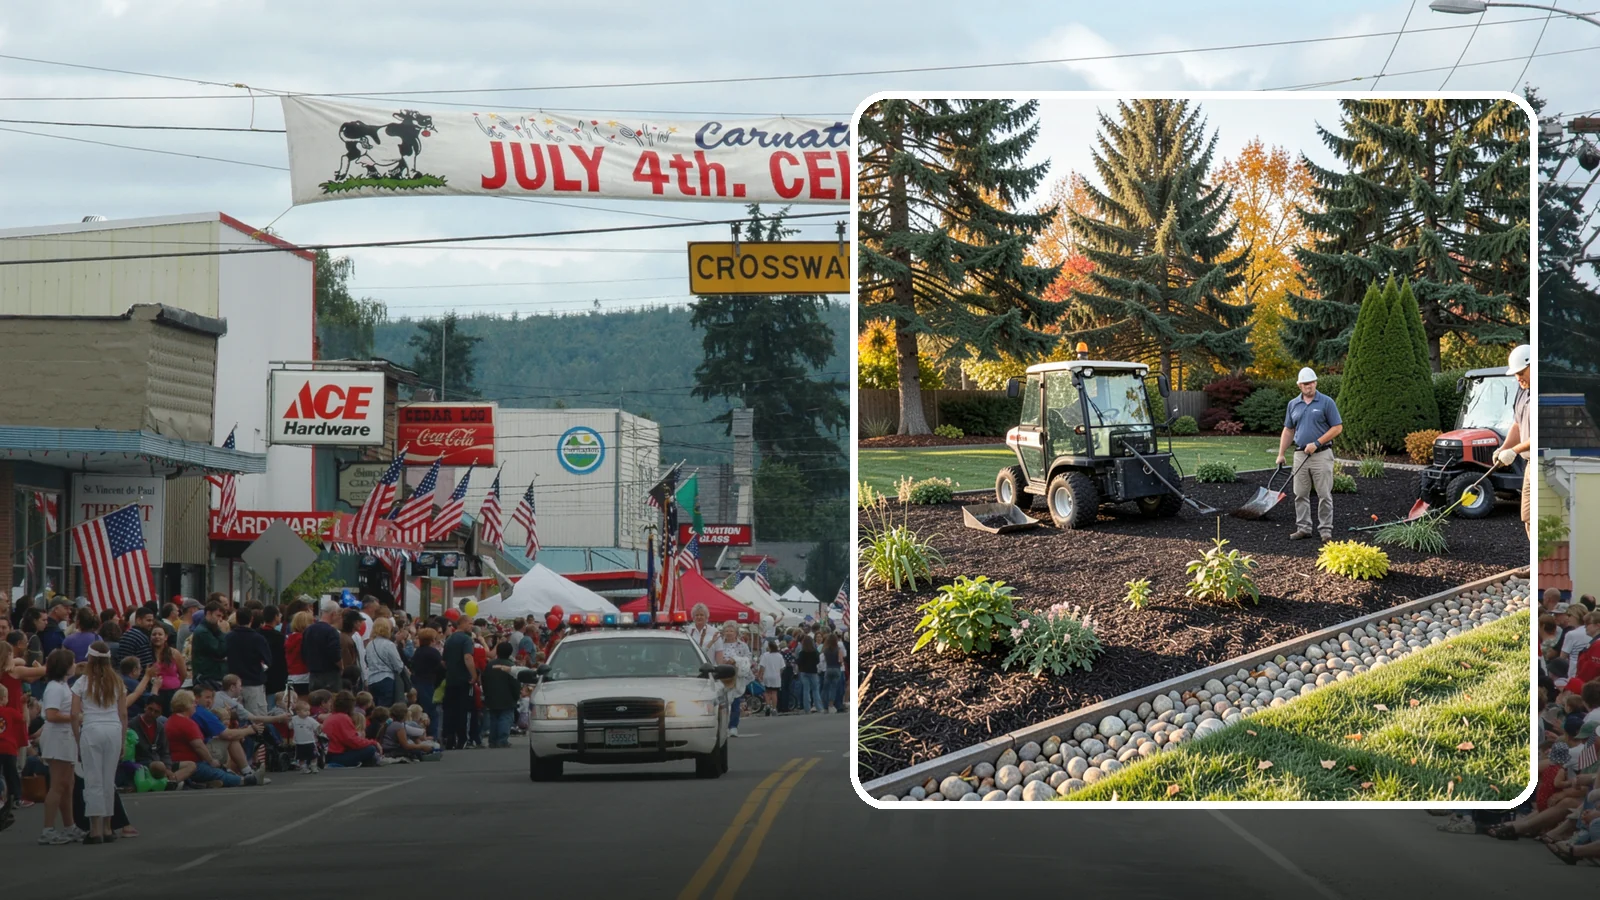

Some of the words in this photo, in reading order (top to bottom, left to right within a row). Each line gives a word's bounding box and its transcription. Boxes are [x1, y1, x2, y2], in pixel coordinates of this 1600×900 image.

[481, 141, 605, 191] JULY
[632, 150, 746, 198] 4th.
[697, 254, 850, 280] CROSSWA
[283, 380, 373, 419] ACE
[406, 409, 452, 421] CEDAR
[283, 421, 371, 436] Hardware
[416, 428, 477, 446] Coca-Cola
[353, 467, 386, 480] Simpl
[83, 485, 93, 494] St.
[96, 485, 124, 495] Vincent
[126, 486, 136, 495] de
[138, 486, 155, 495] Paul
[81, 503, 153, 521] THT
[688, 526, 741, 535] CRNATION
[699, 535, 730, 543] GLASS
